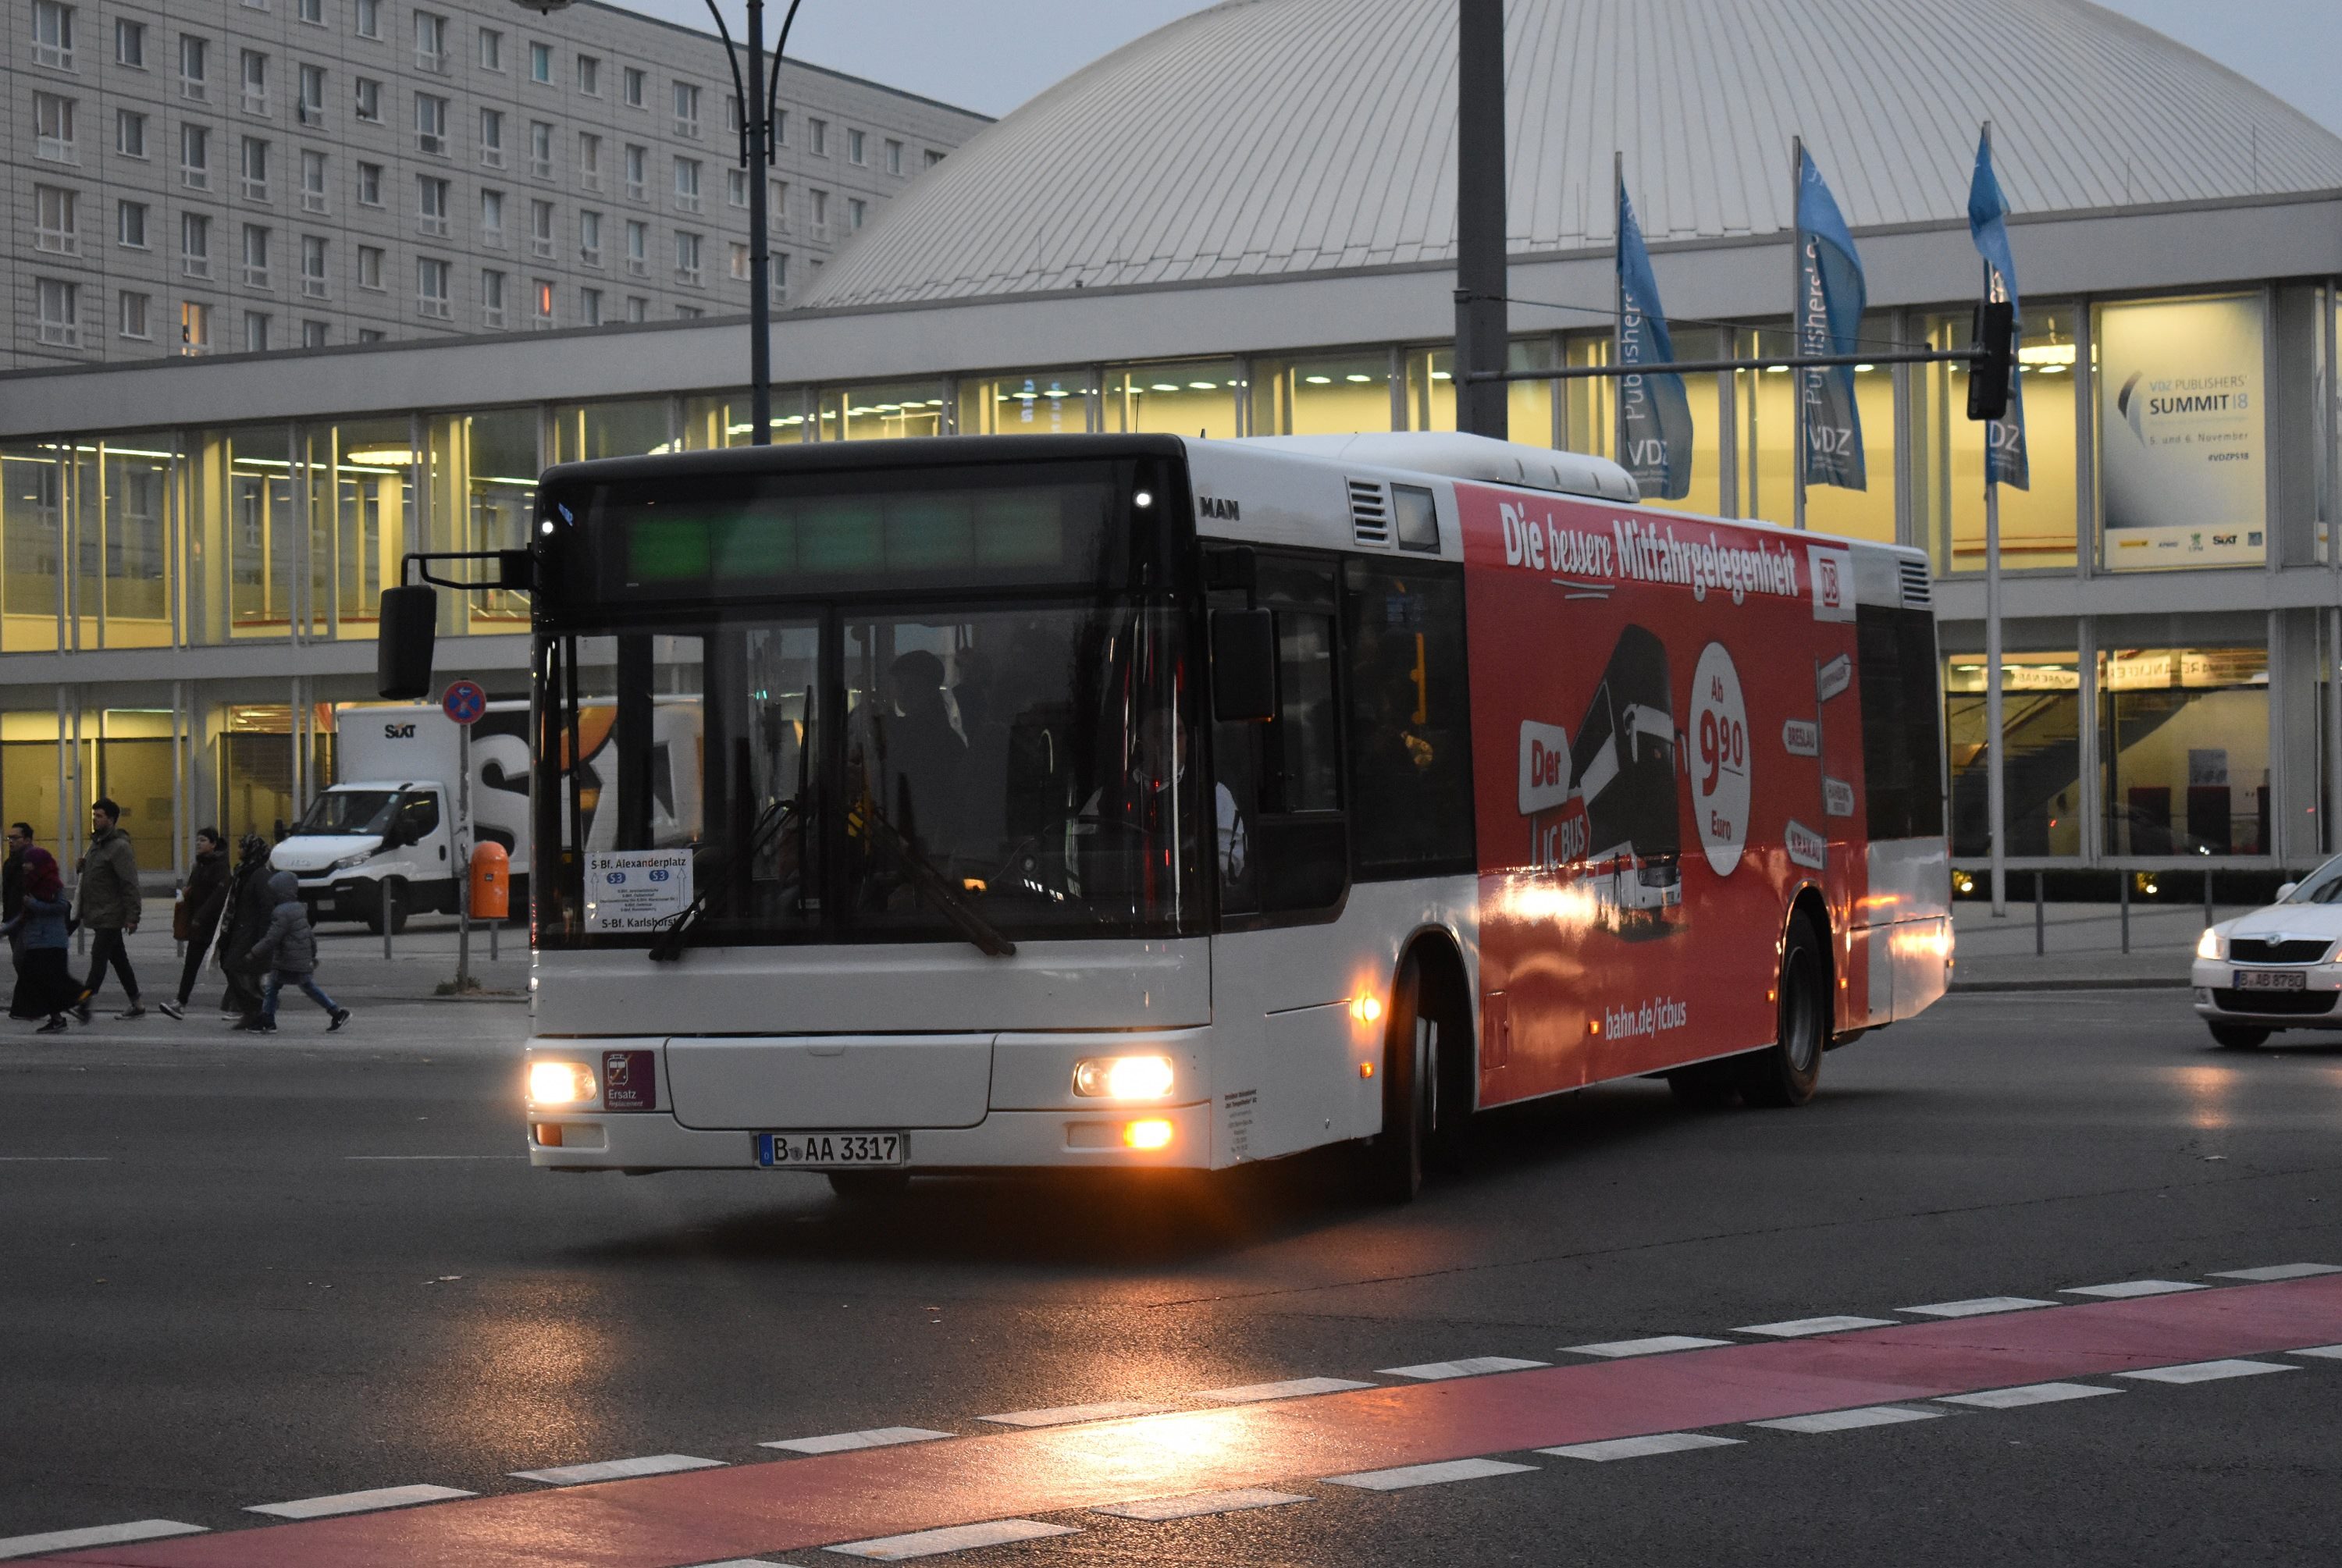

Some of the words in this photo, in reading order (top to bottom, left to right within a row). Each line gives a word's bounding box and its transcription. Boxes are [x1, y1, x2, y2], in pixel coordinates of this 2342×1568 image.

[2150, 381, 2172, 392] VDZ
[2150, 394, 2229, 414] SUMMIT
[1809, 425, 1853, 456] VDZ
[2198, 430, 2248, 443] November
[1199, 496, 1240, 521] MAN
[1499, 502, 1545, 571] Die
[1547, 512, 1614, 578] bessere
[1613, 518, 1799, 606] Mitfahrgelegenheit
[1711, 675, 1724, 703] Ab
[1532, 739, 1561, 788] Der
[1711, 810, 1732, 841] Euro
[1543, 825, 1559, 873] IC
[1561, 814, 1586, 864] BUS
[591, 860, 613, 869] S-Bf.
[616, 857, 686, 869] Alexanderplatz
[608, 873, 624, 884] S3
[652, 870, 667, 881] S3
[602, 919, 625, 929] S-Bf.
[1605, 995, 1686, 1040] bahn.de/icbus
[609, 1089, 636, 1100] Ersatz
[774, 1138, 788, 1161] B
[805, 1137, 835, 1161] AA
[840, 1136, 897, 1161] 3317
